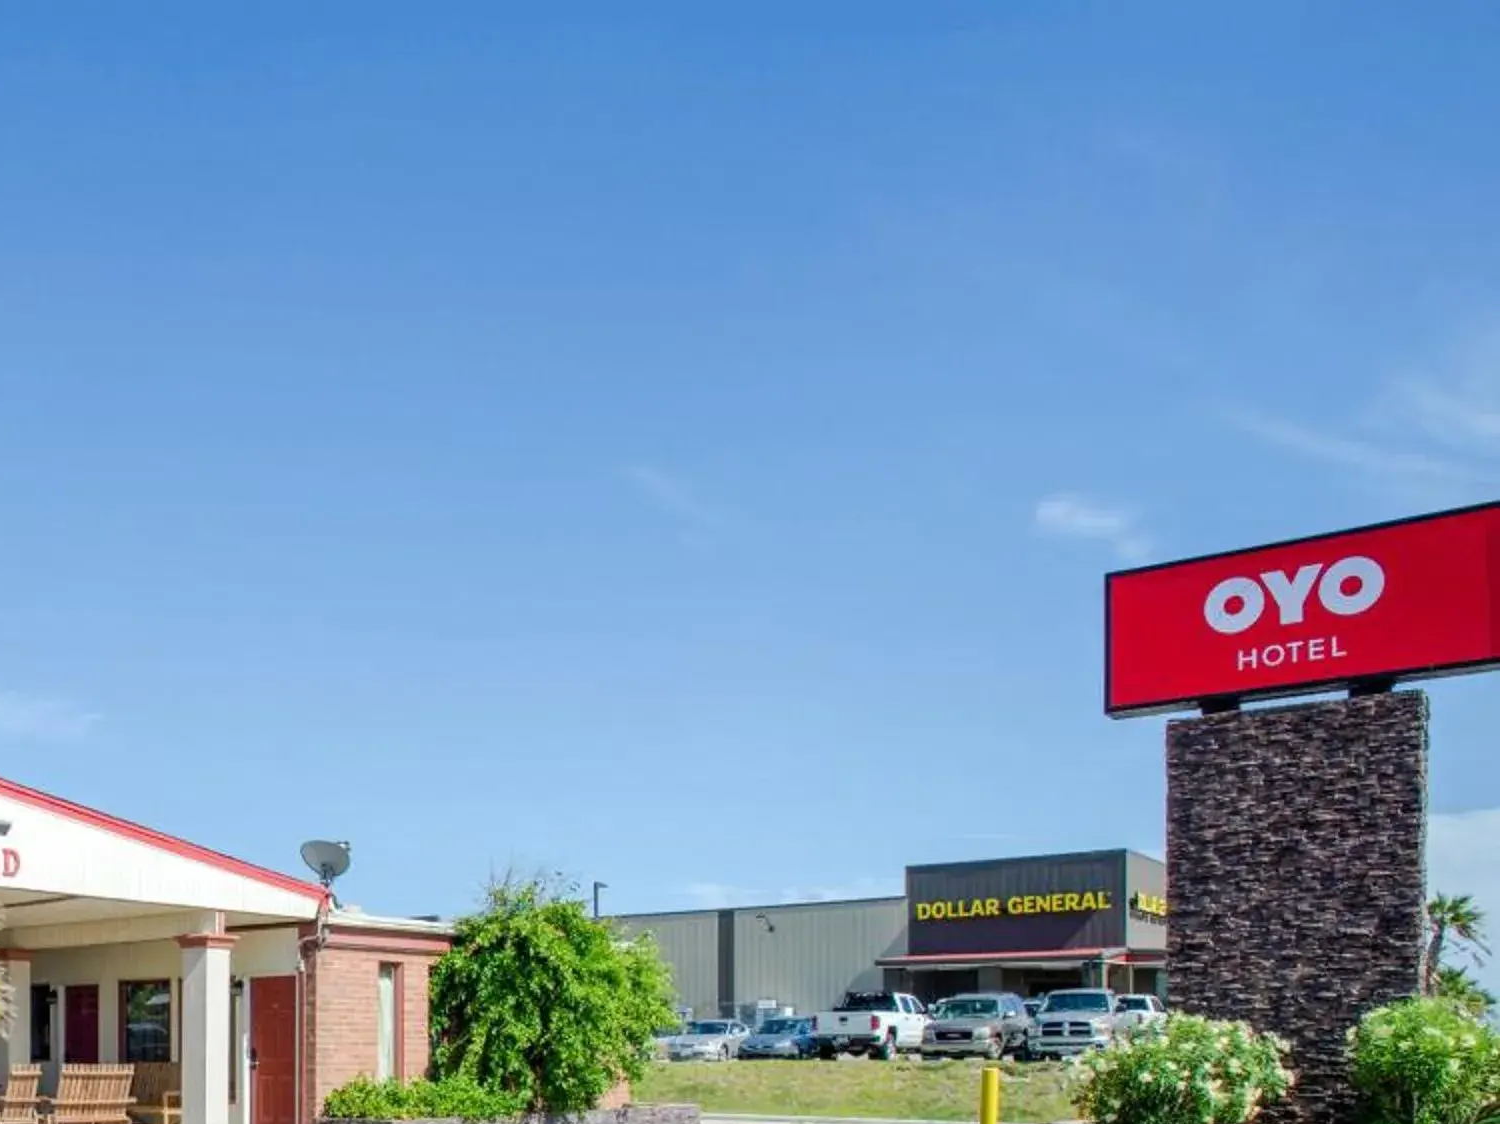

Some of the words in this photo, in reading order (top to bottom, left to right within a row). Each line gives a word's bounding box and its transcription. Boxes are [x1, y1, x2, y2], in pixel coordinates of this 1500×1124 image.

[1203, 555, 1385, 634] OYO
[1237, 635, 1347, 671] HOTEL
[916, 898, 1000, 921] DOLLAR
[1007, 891, 1112, 915] GENERAL
